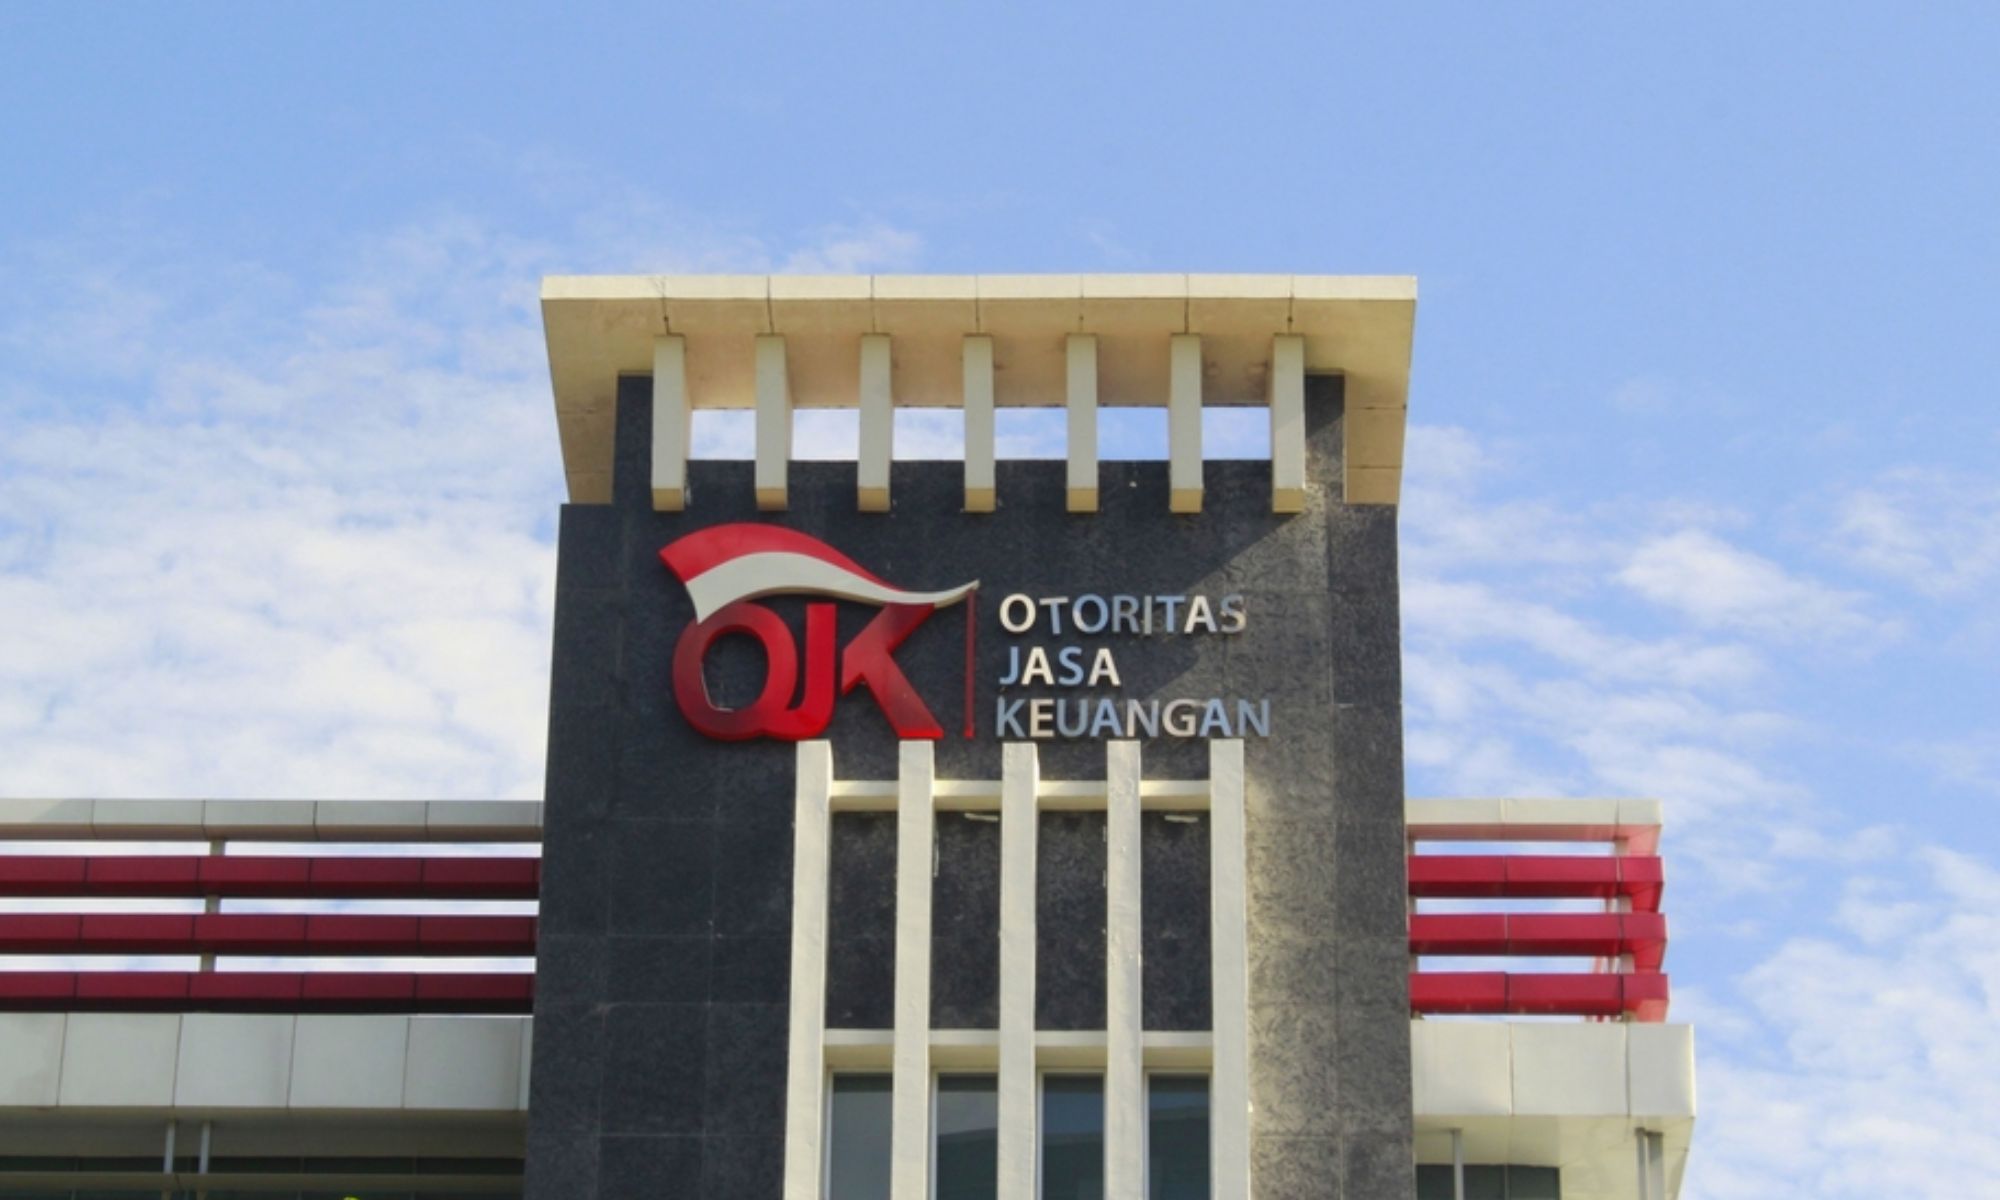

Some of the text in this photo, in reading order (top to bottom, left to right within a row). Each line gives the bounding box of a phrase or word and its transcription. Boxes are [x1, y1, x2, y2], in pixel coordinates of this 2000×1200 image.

[1000, 593, 1247, 635] OTORITAS
[672, 600, 944, 740] OJK
[999, 646, 1122, 686] JASA
[996, 696, 1271, 737] KEUANGAN
